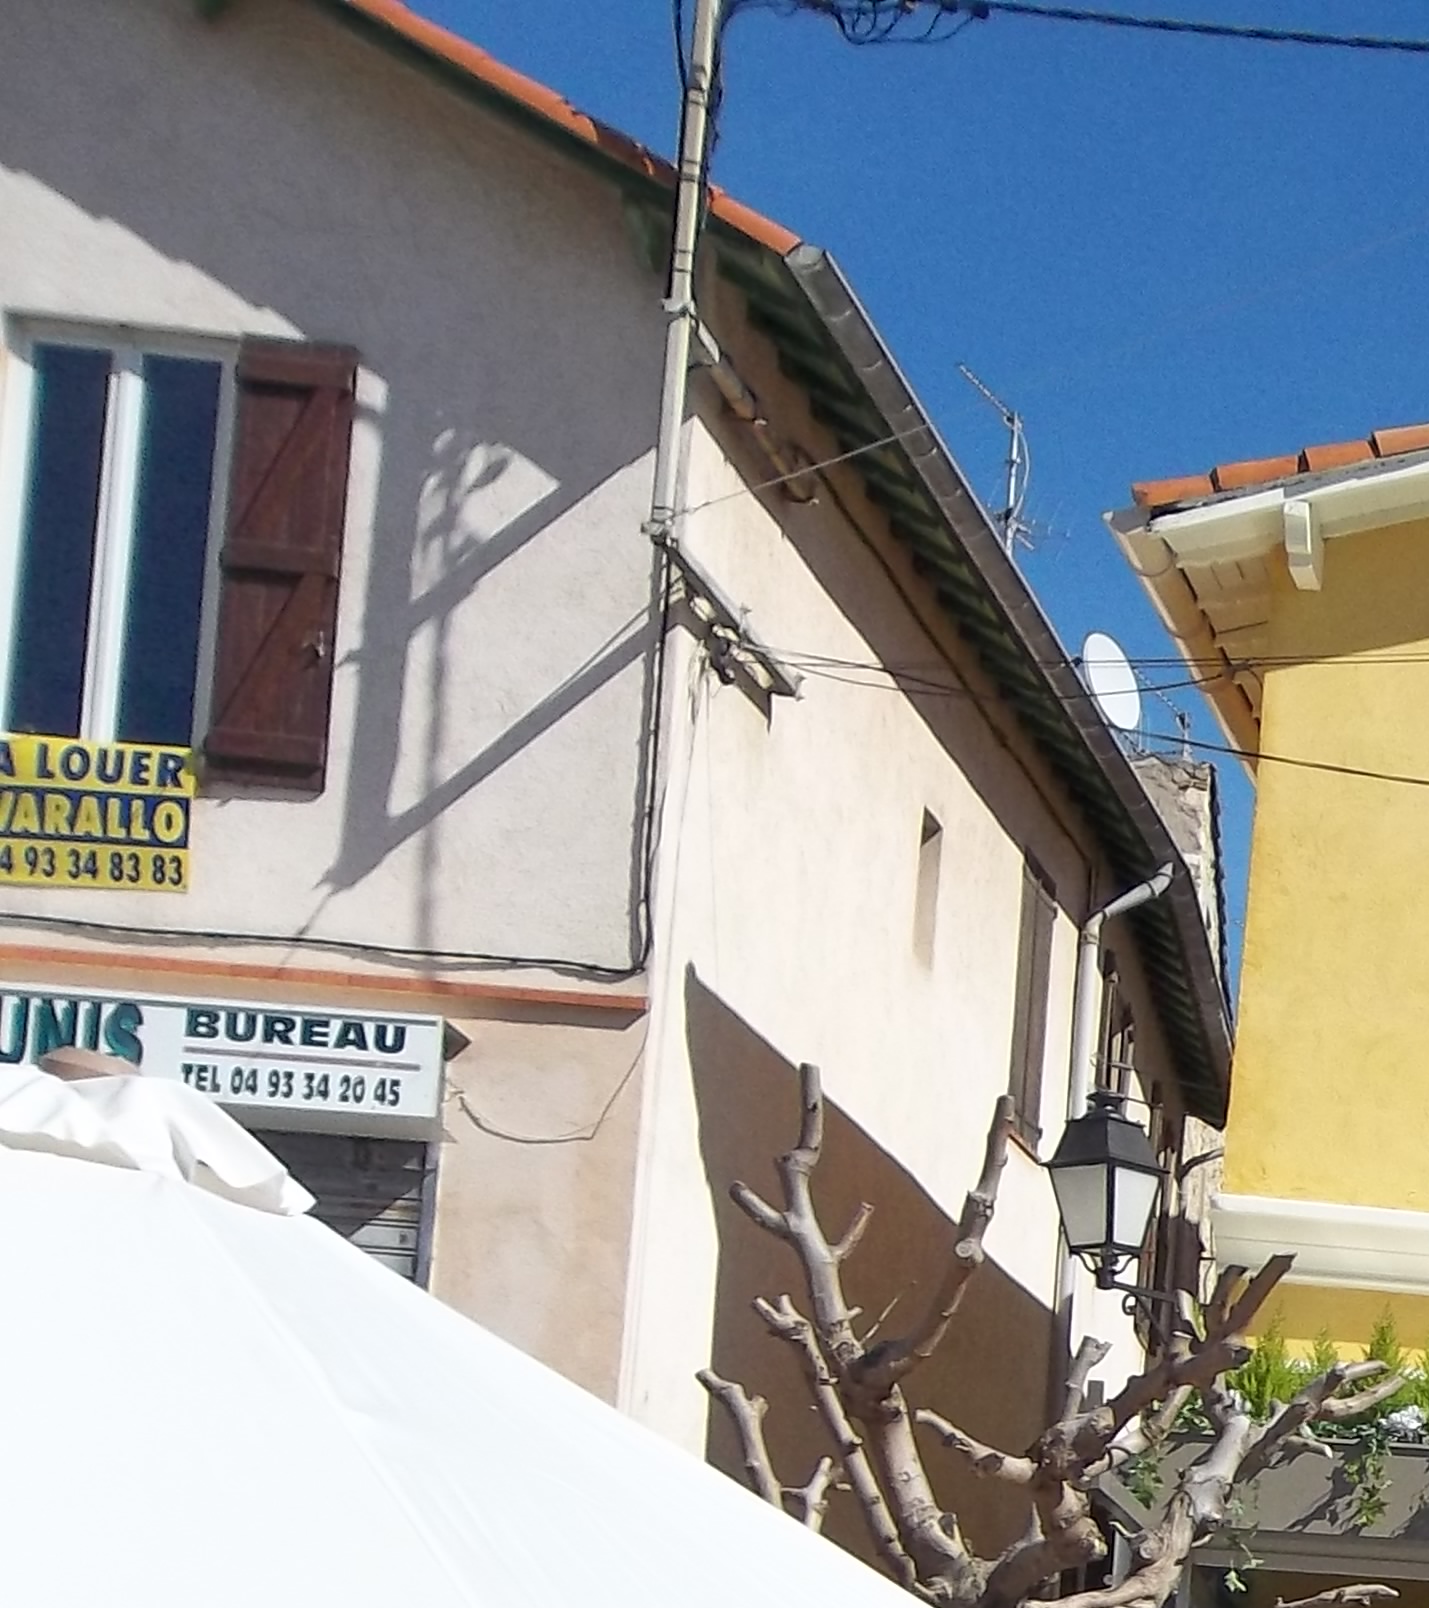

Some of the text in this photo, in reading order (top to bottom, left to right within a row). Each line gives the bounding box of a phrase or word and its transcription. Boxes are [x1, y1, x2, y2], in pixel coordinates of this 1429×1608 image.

[36, 743, 186, 788] LOUER
[24, 846, 55, 877] 93
[67, 848, 97, 880] 34
[109, 852, 140, 883] 83
[151, 854, 183, 885] 83
[185, 1006, 407, 1055] BUREAU
[182, 1062, 401, 1107] TEL 04 93 34 20 45
